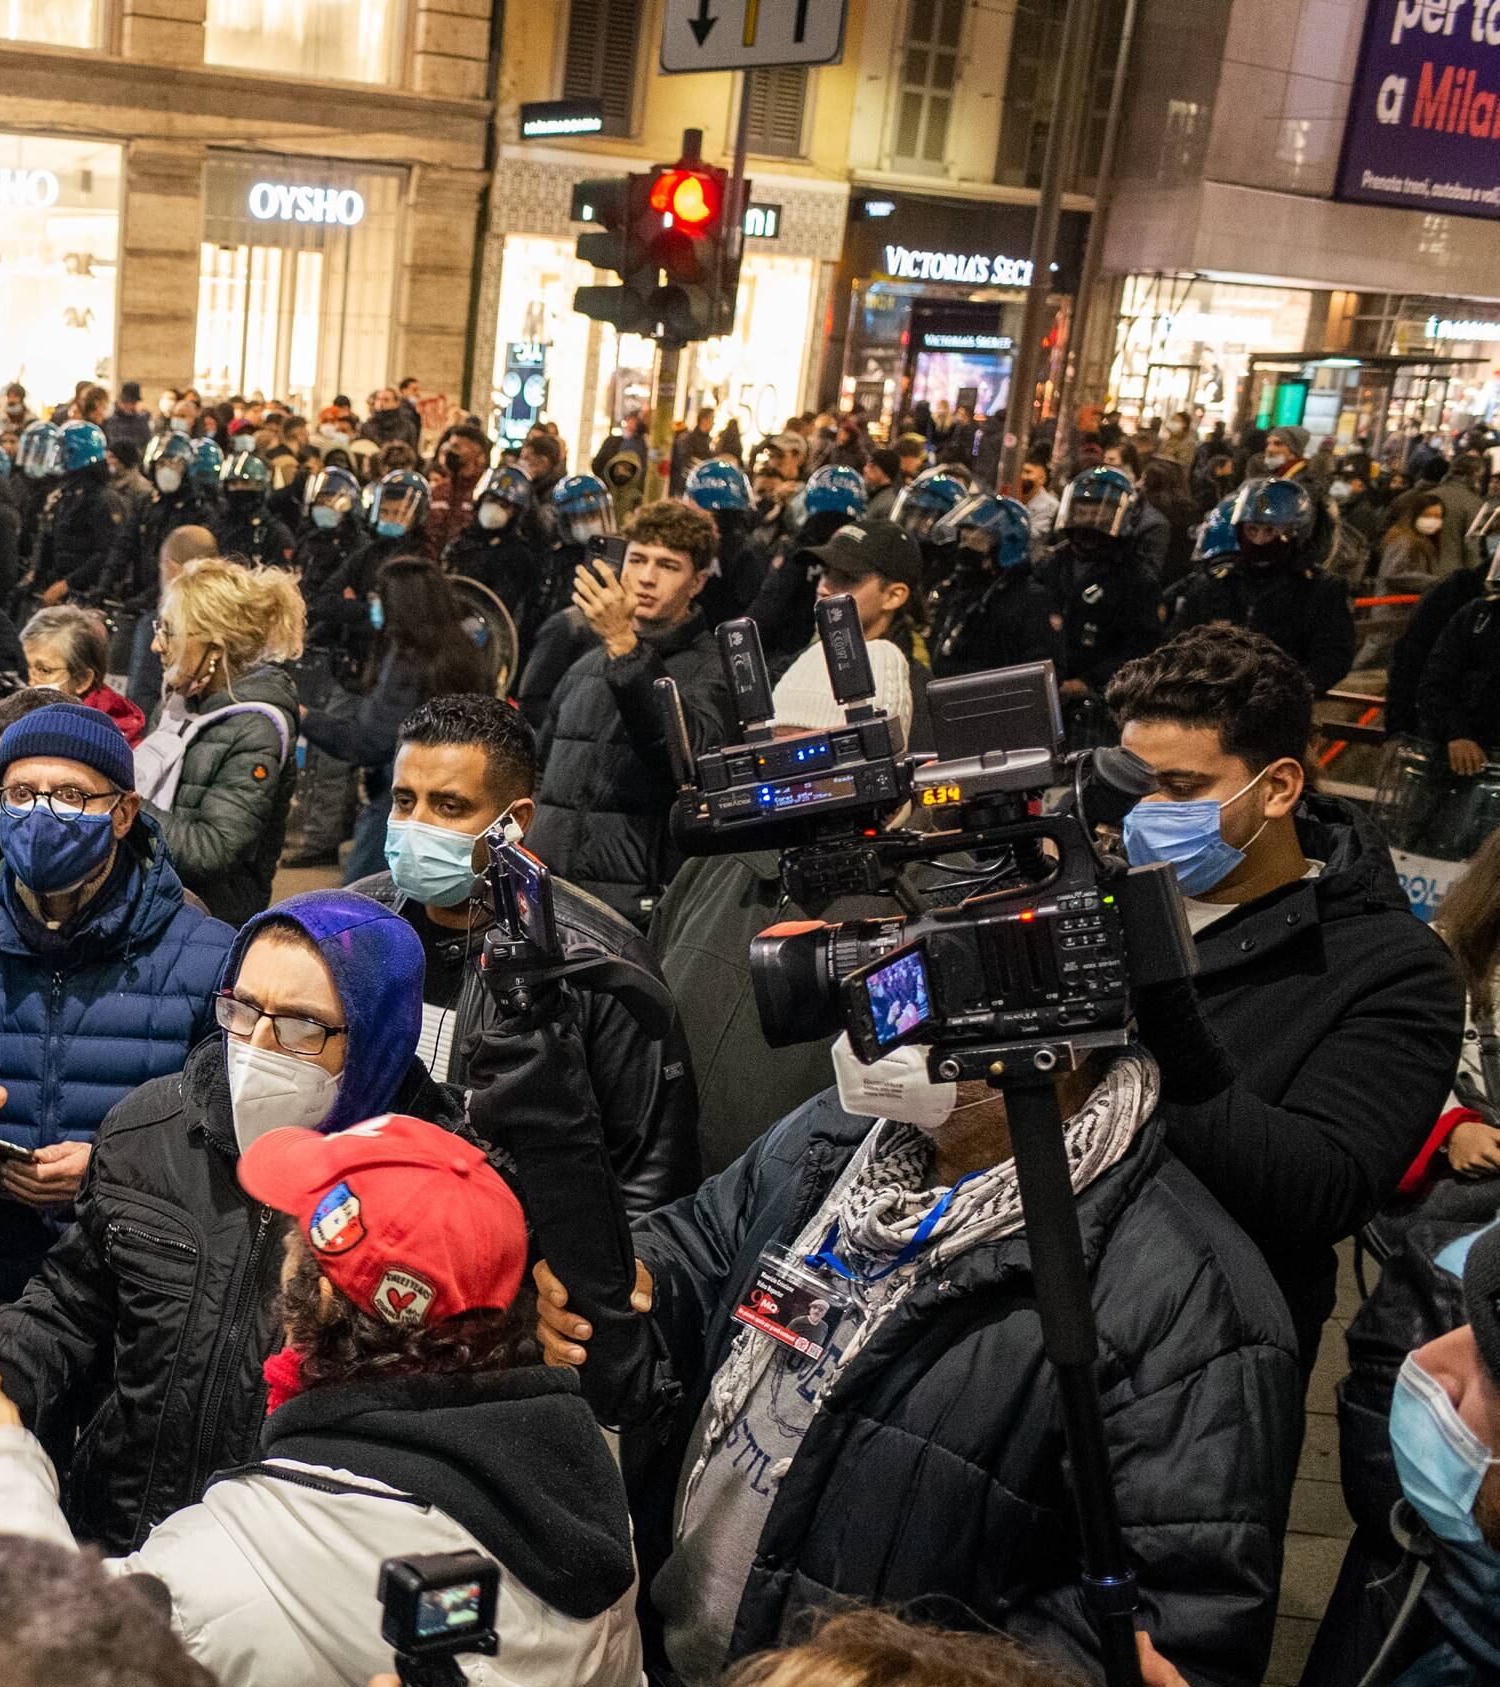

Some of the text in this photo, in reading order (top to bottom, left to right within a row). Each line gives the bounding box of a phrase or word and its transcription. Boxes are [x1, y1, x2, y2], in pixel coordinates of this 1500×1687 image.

[1376, 61, 1500, 140] a Mila
[249, 183, 364, 225] OYSHO
[886, 245, 991, 284] VICTORIA'S
